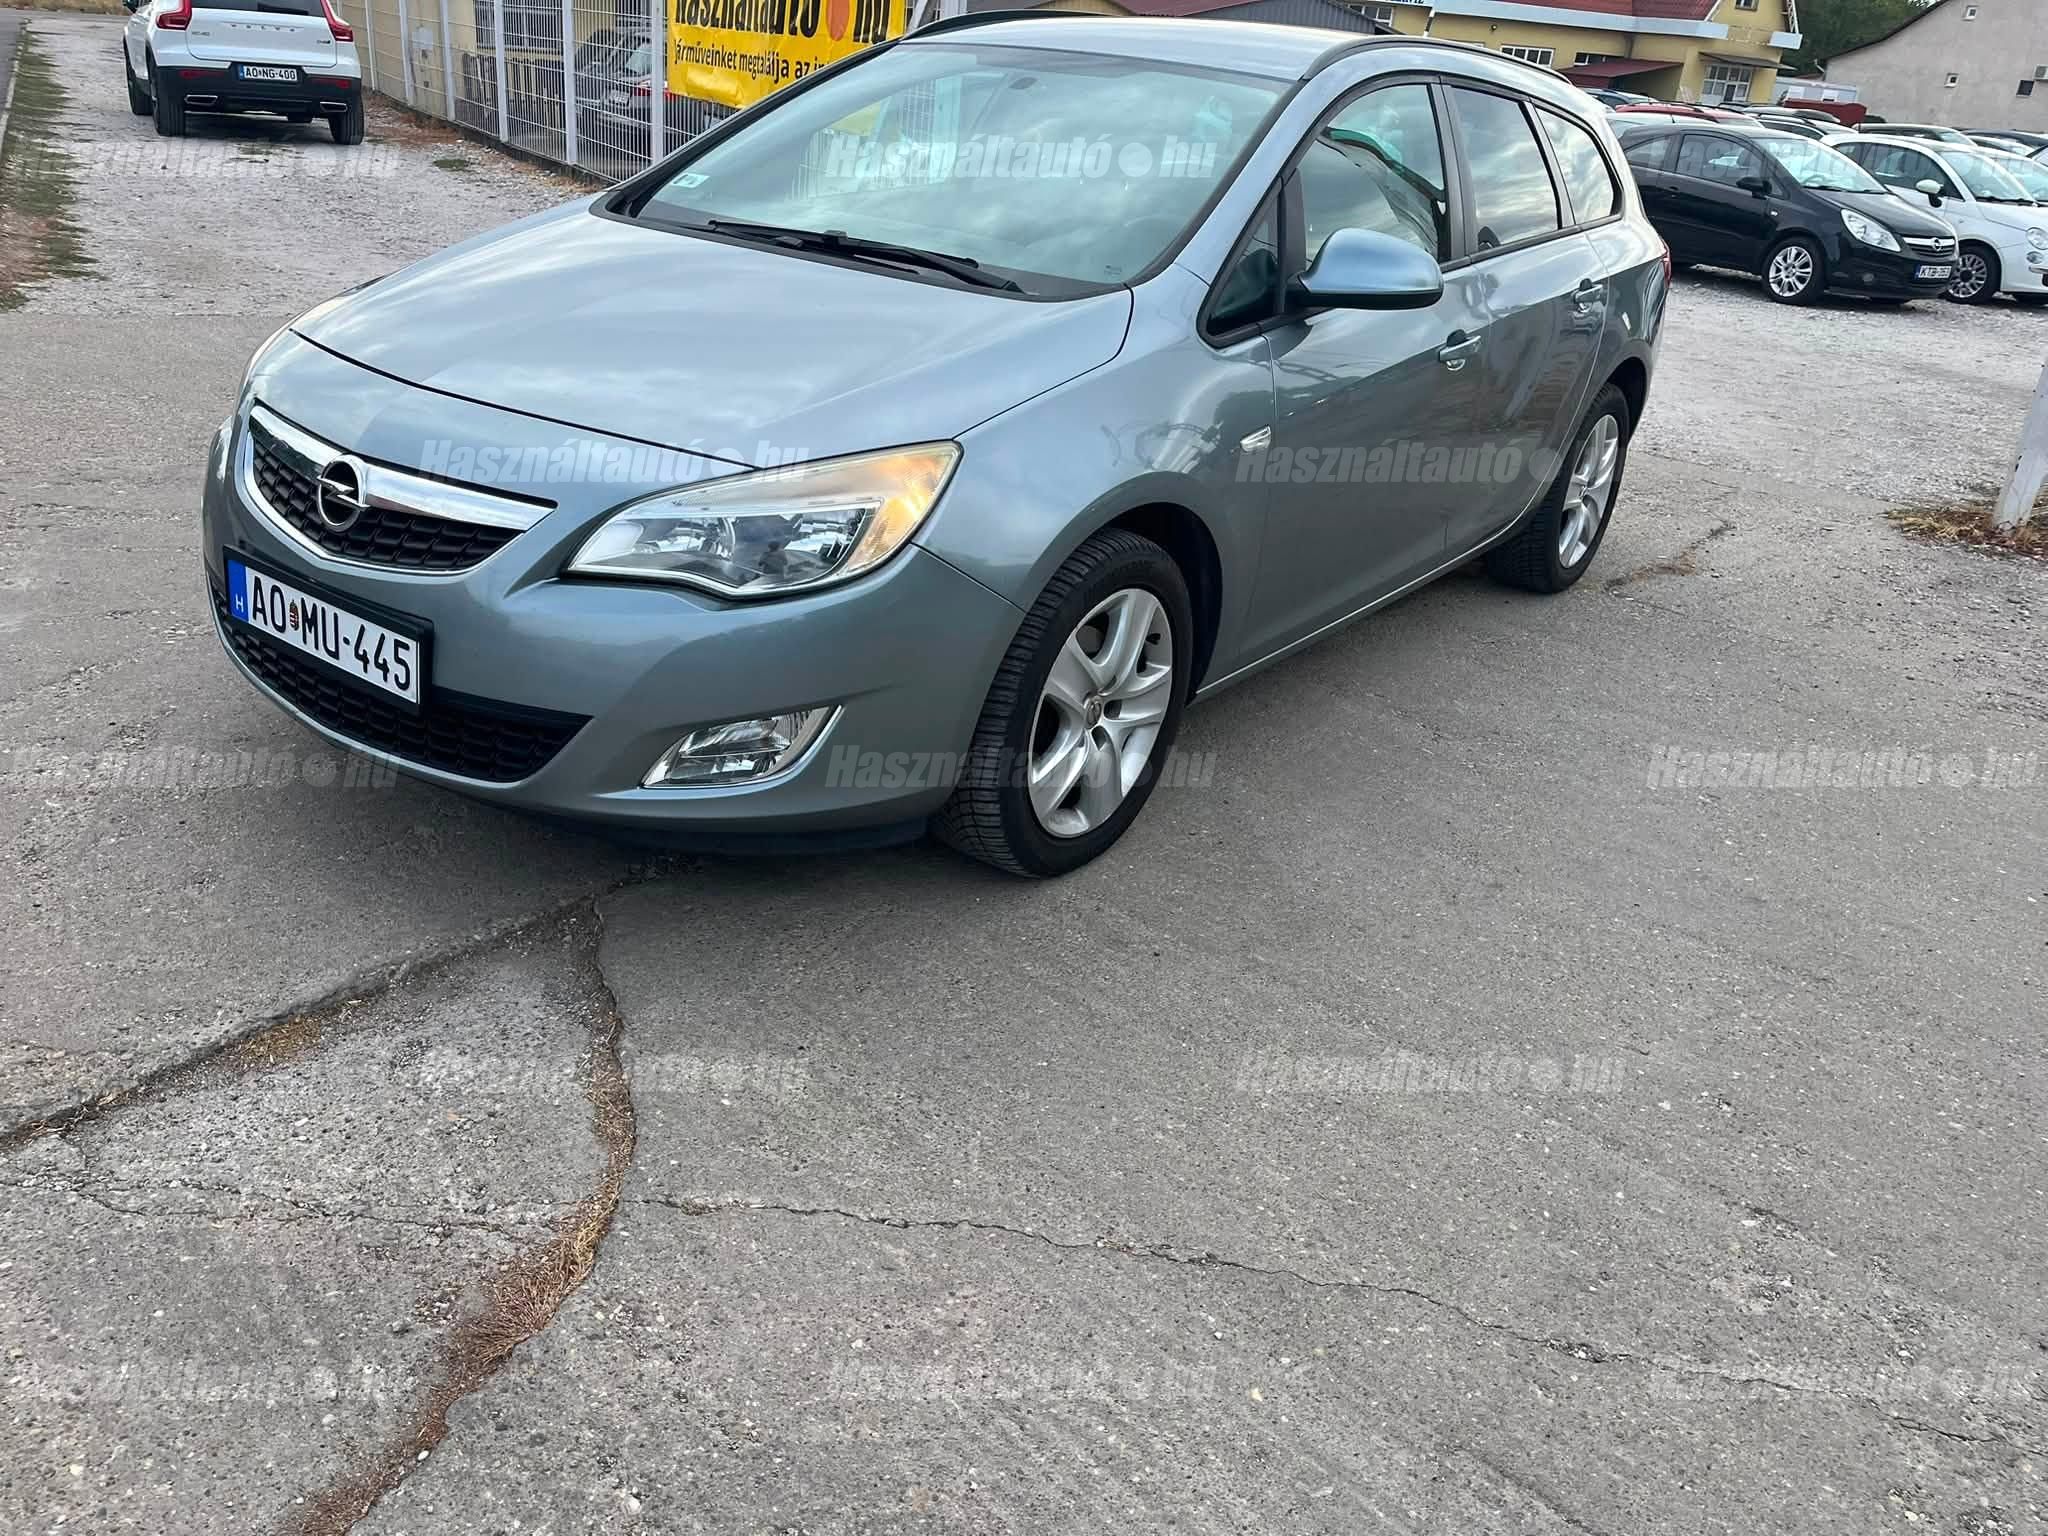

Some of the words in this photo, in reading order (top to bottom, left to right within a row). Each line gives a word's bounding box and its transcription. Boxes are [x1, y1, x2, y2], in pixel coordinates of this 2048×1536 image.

[739, 49, 789, 84] megtalálja
[795, 60, 811, 79] az
[252, 575, 287, 633] AO
[301, 597, 411, 691] MU-445
